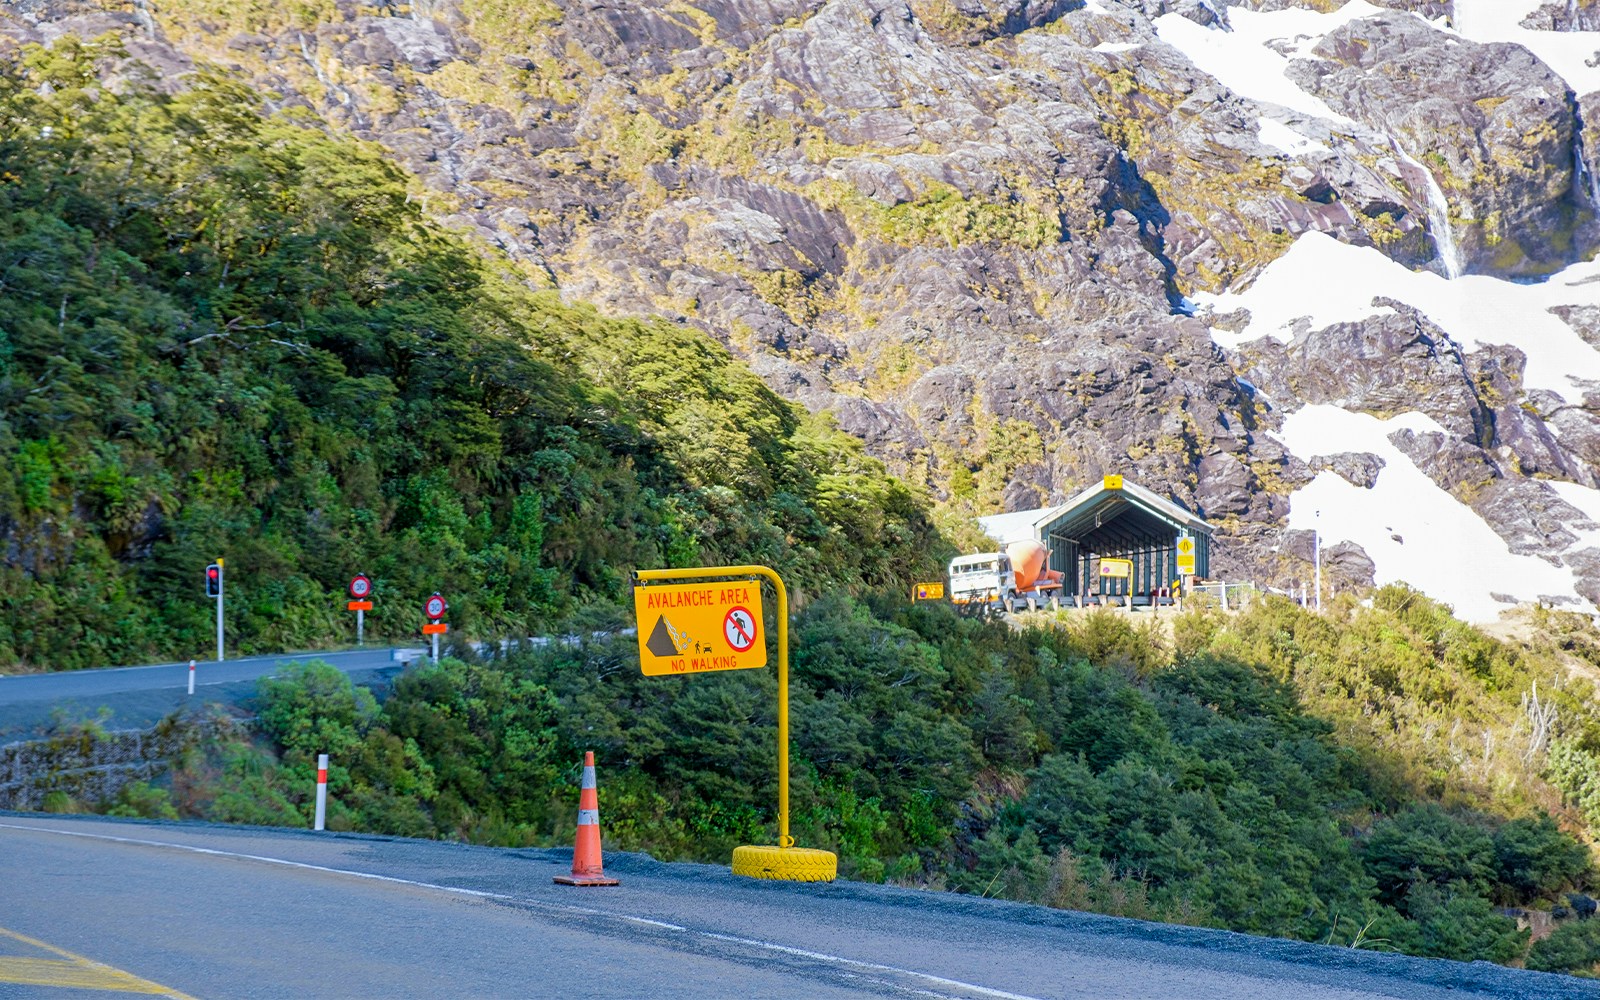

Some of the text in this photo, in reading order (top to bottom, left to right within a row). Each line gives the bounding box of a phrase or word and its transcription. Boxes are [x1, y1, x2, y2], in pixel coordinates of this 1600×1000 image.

[355, 582, 365, 591] 30
[648, 588, 749, 608] AVALANCHE AREA
[429, 603, 441, 612] 30
[672, 656, 737, 671] NO WALKING
